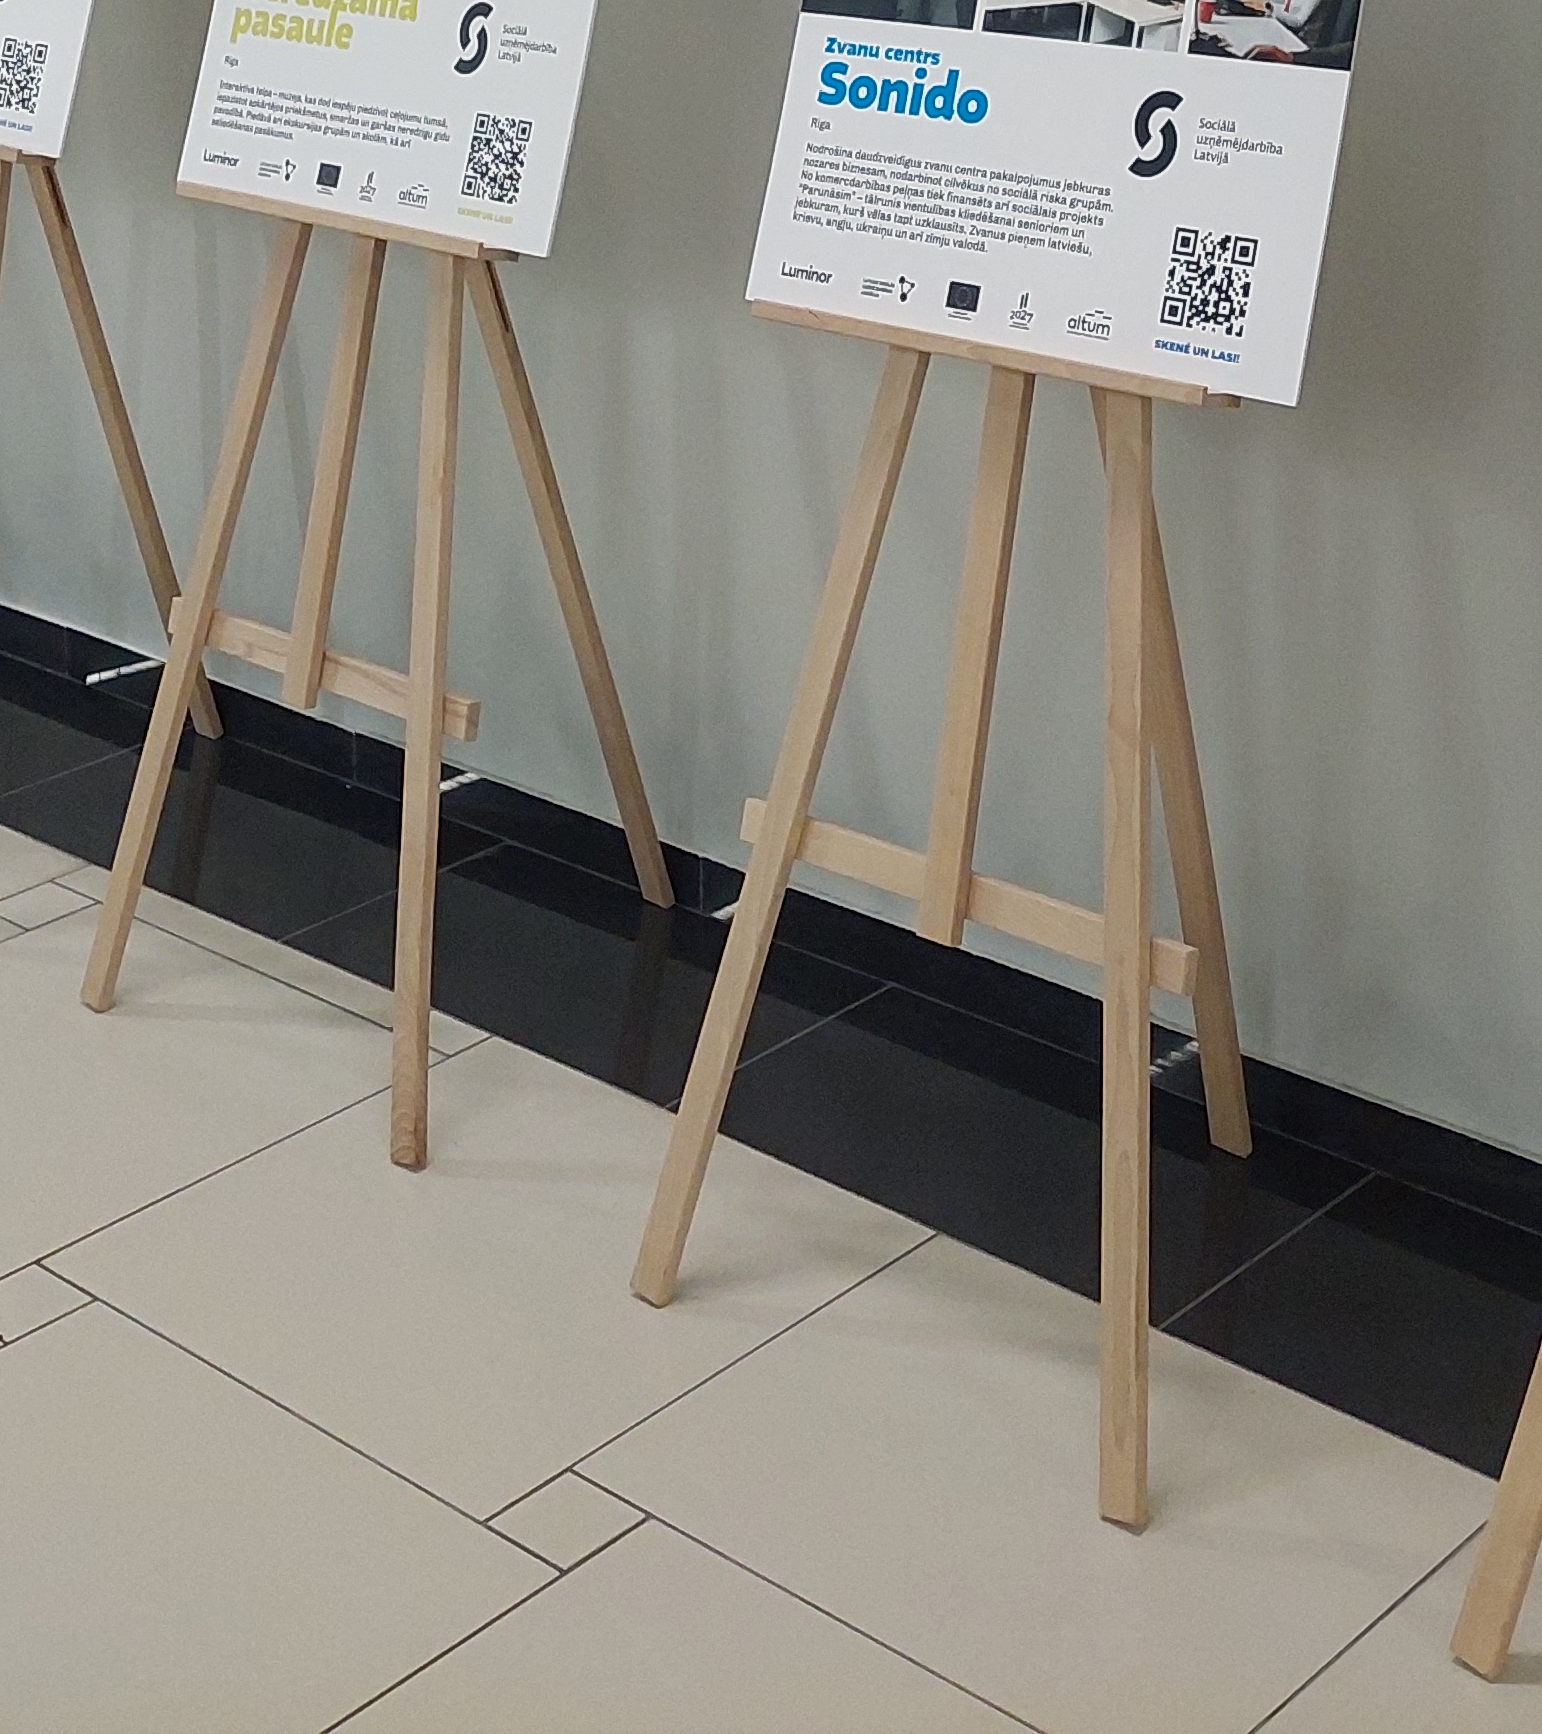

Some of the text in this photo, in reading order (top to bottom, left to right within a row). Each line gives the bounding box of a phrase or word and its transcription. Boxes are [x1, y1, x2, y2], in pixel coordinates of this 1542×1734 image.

[230, 7, 353, 50] pasaule
[825, 37, 941, 64] Zvanu centrs
[817, 62, 988, 123] Sonido
[1199, 118, 1235, 132] Sociālā
[204, 148, 239, 167] Luminor
[1194, 149, 1228, 166] Latvijā
[398, 190, 428, 205] altum
[781, 262, 833, 284] Luminor
[1009, 310, 1033, 323] 2027
[1068, 314, 1110, 336] altum
[1153, 338, 1191, 354] SKENĒ
[1192, 345, 1209, 358] UN
